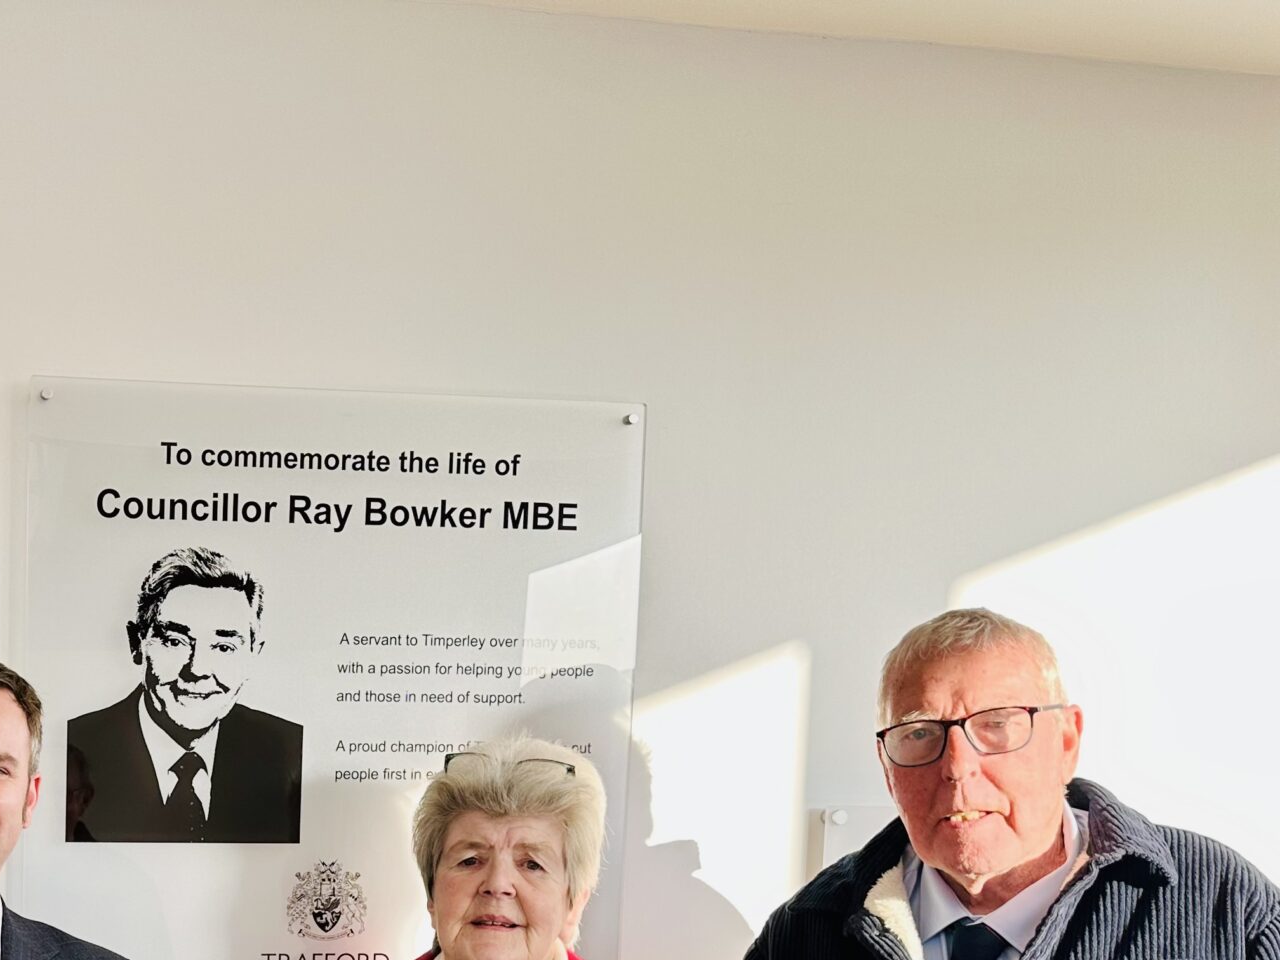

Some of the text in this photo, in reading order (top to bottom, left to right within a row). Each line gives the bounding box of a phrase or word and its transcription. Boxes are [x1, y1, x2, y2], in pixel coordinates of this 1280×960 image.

[161, 442, 522, 476] To commemorate the life of
[97, 489, 577, 532] Councillor Ray Bowker MBE
[339, 632, 600, 651] A servant to Timperley over many years,
[337, 662, 364, 674] with
[368, 665, 376, 674] a
[380, 663, 431, 677] passion
[435, 663, 453, 675] for
[456, 664, 503, 679] helping
[550, 665, 594, 680] people
[336, 690, 526, 707] and those in need of support.
[335, 740, 346, 752] A
[349, 740, 387, 755] proud
[390, 740, 454, 756] champion
[335, 768, 379, 783] people
[383, 768, 407, 781] first
[411, 768, 422, 780] in
